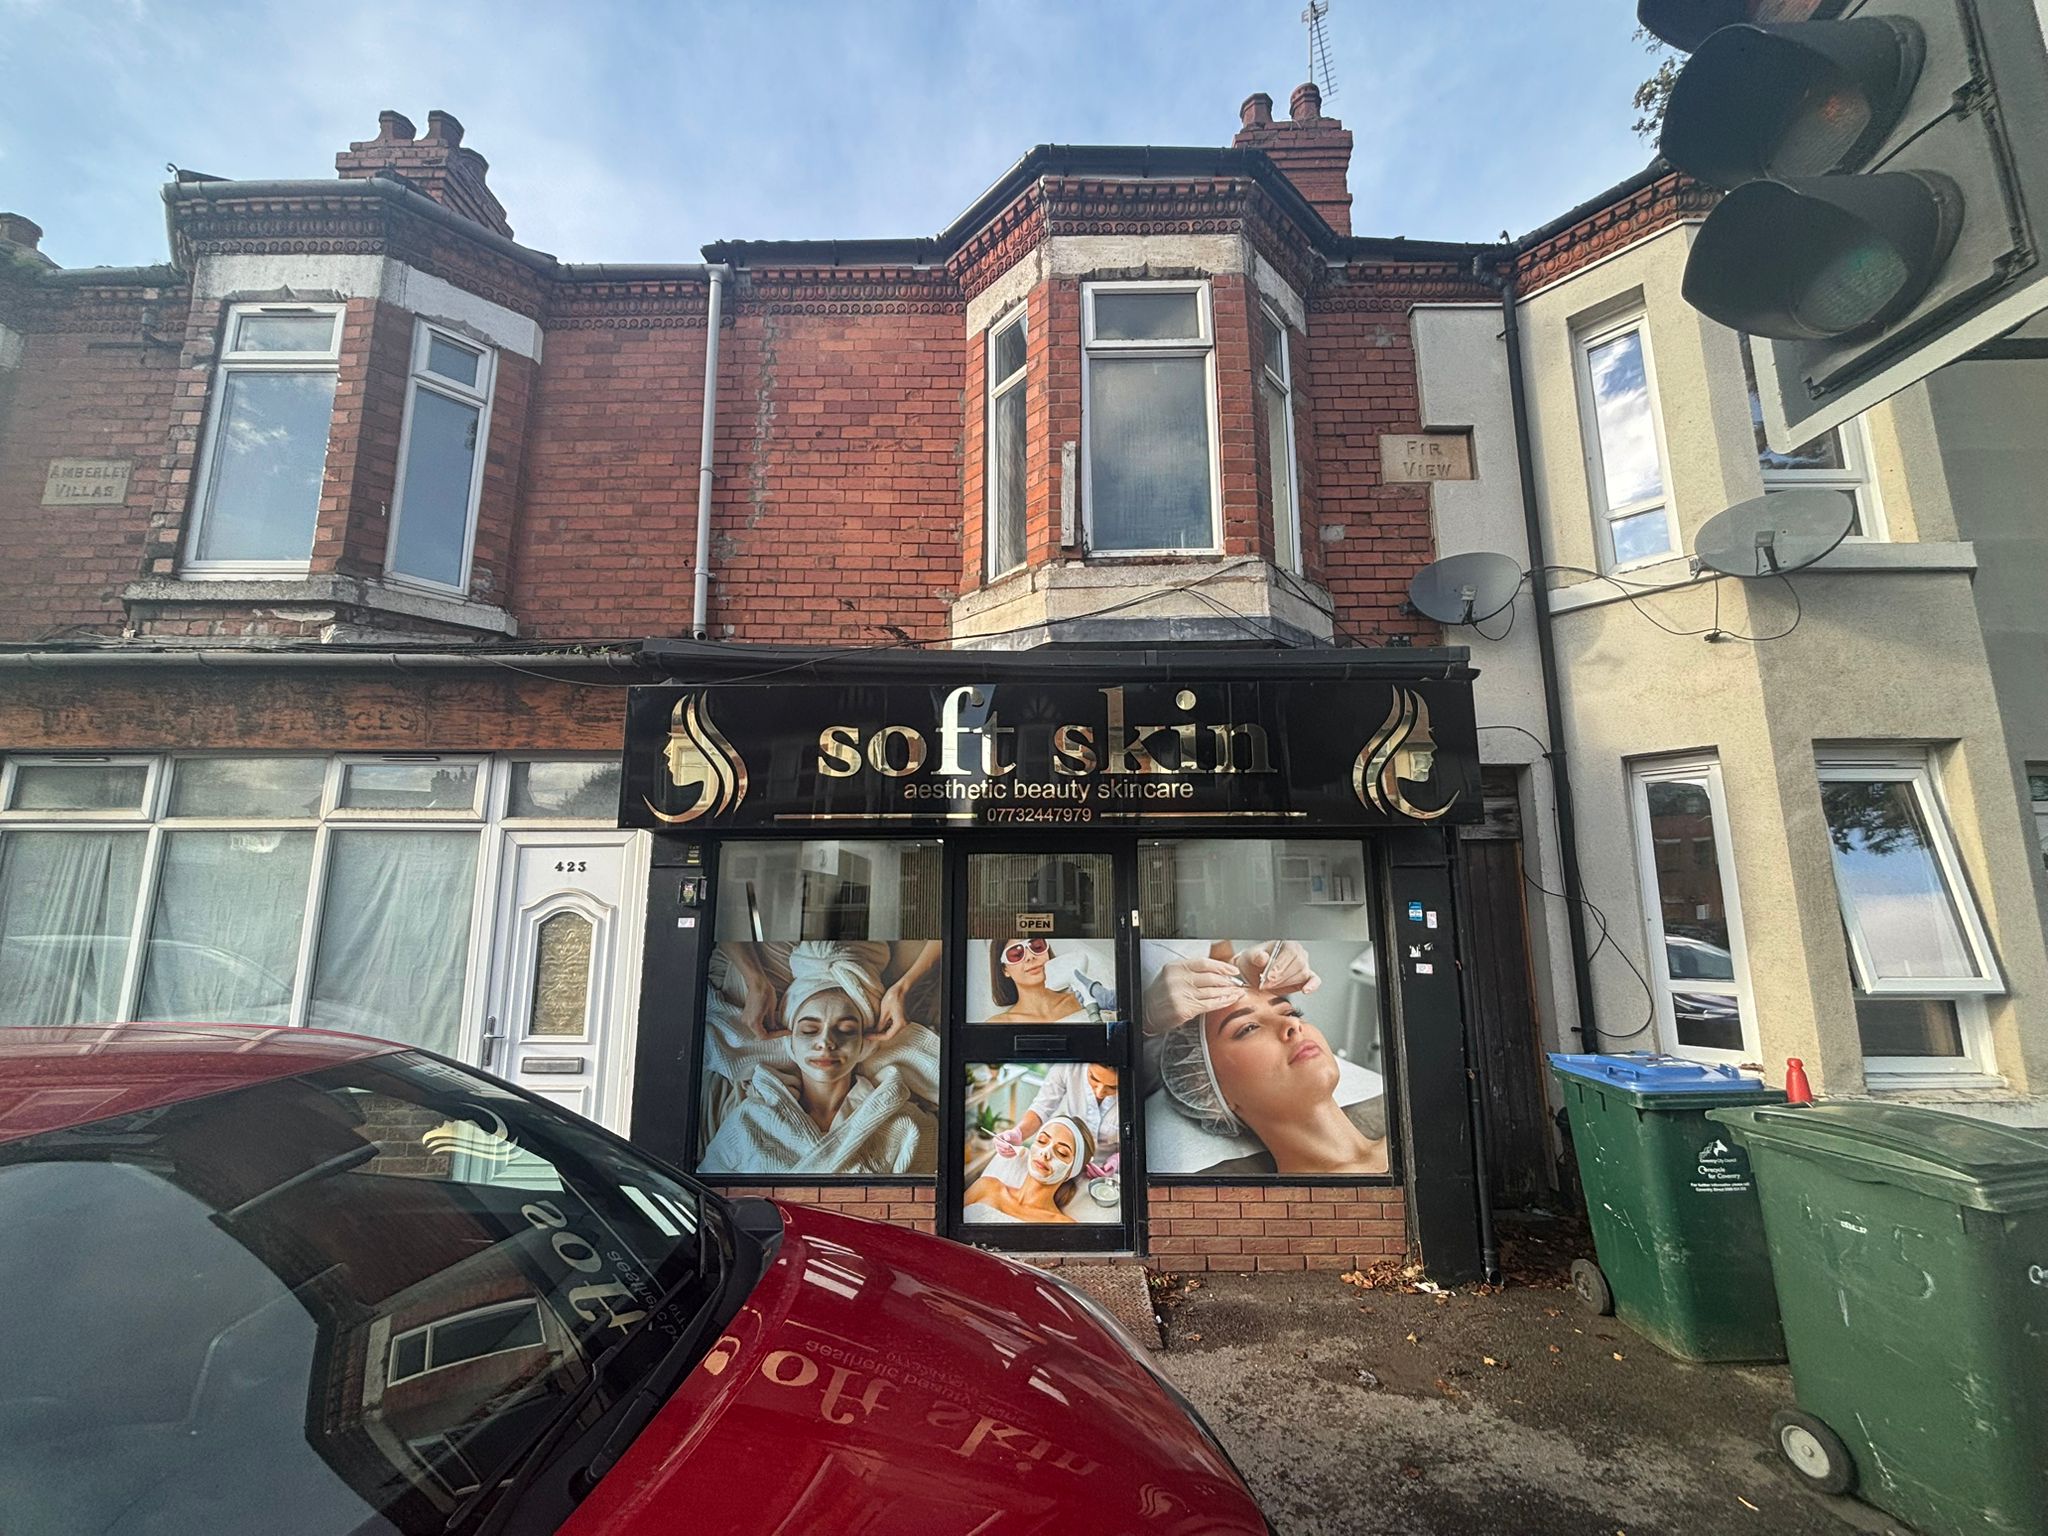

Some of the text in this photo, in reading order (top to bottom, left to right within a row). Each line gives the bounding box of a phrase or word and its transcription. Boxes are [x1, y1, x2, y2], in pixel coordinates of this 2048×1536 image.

[1406, 441, 1443, 456] FIR
[50, 465, 129, 479] AMBERLEY
[1403, 462, 1451, 477] VIEW
[56, 484, 115, 498] VILLAS
[818, 686, 1278, 777] soft skin
[904, 779, 1194, 803] aesthetic beauty skincare
[987, 808, 1092, 823] 07732447979
[554, 861, 587, 872] 423
[1019, 919, 1051, 929] OPEN
